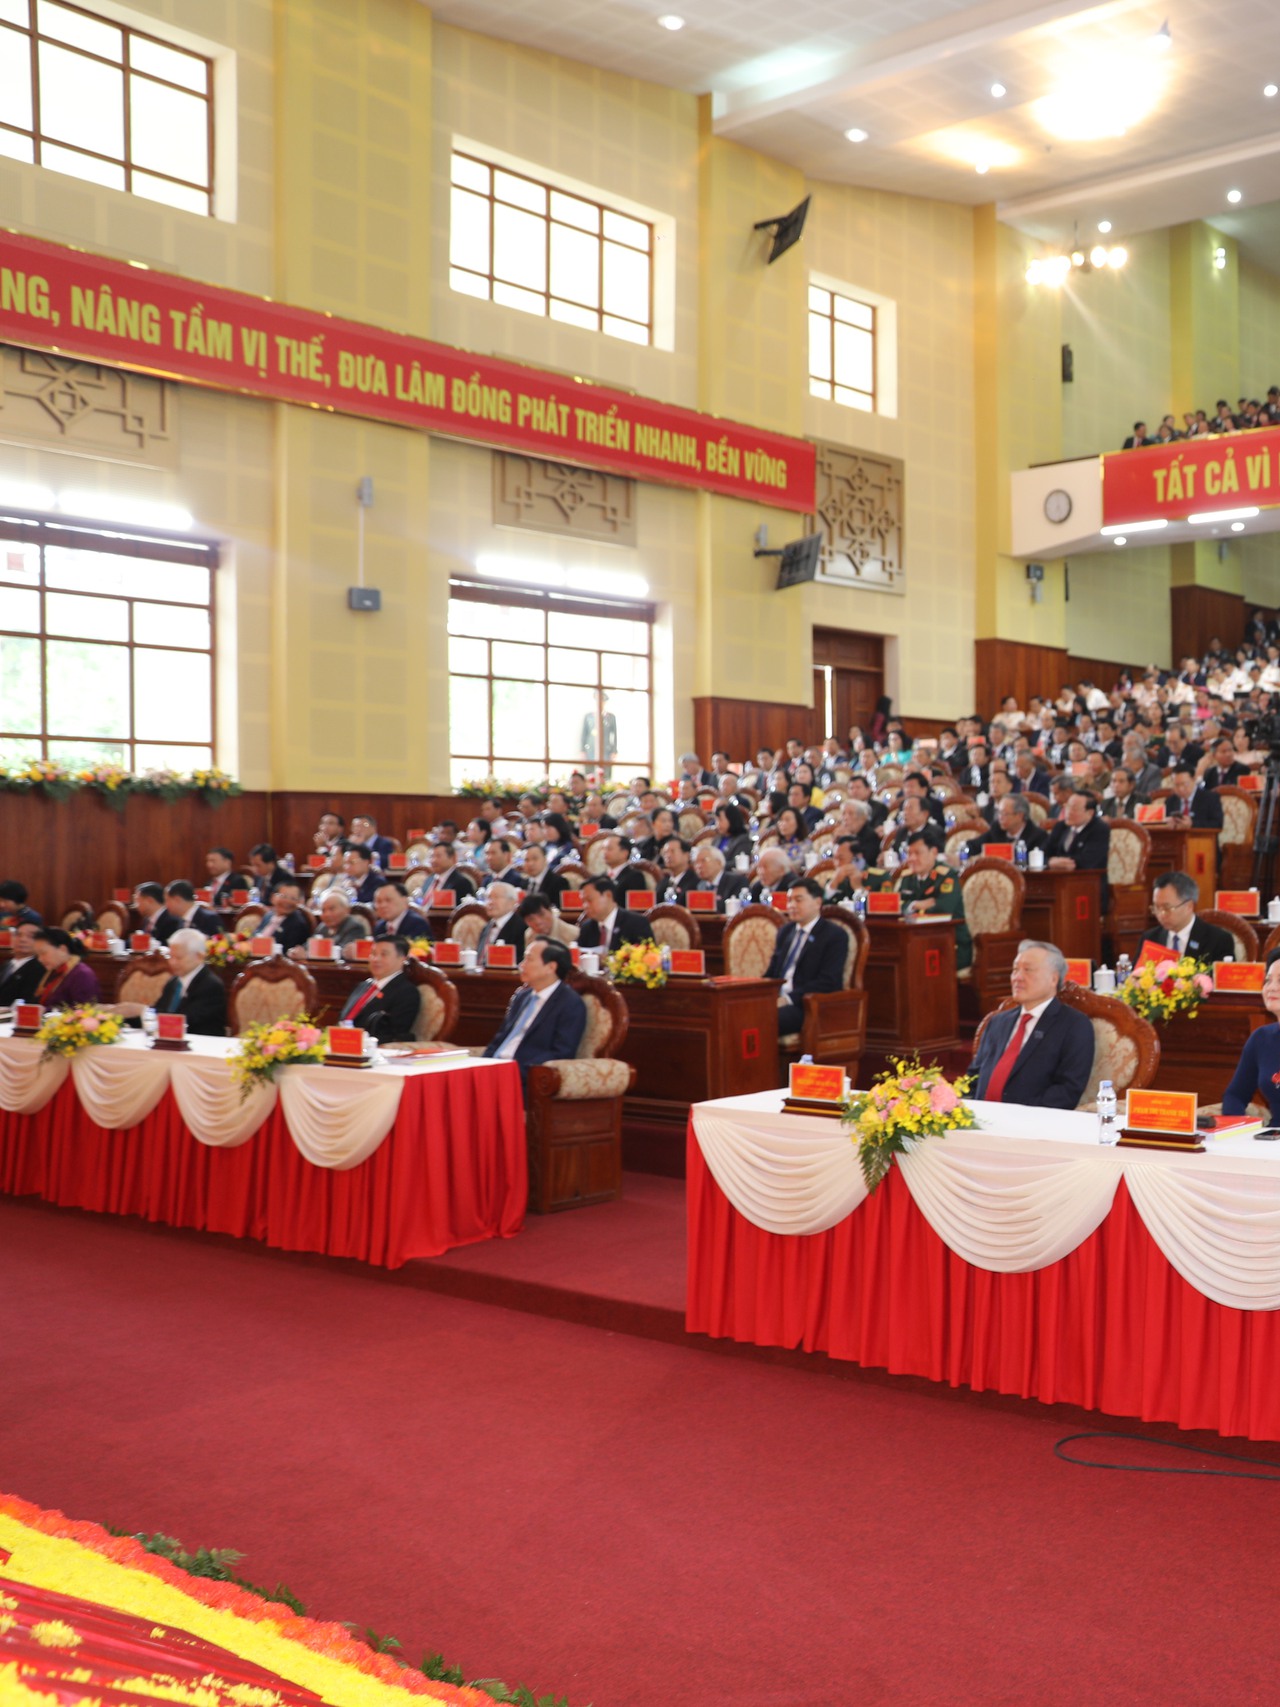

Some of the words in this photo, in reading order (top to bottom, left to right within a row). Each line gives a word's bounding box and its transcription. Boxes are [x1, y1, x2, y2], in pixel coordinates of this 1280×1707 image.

[71, 284, 161, 345] NÂNG
[170, 302, 233, 361] TẦM
[241, 327, 268, 377] VỊ
[275, 333, 331, 387] THẾ,
[338, 351, 389, 397] ĐƯA
[396, 361, 446, 409] LÂM
[452, 371, 512, 425] ĐỒNG
[517, 394, 570, 437] PHÁT
[574, 404, 630, 452] TRIỂN
[635, 422, 702, 473] NHANH,
[744, 447, 787, 489] VỮNG
[1153, 453, 1197, 503] TẤT
[1205, 447, 1239, 496] CẢ
[1247, 454, 1270, 490] VÌ
